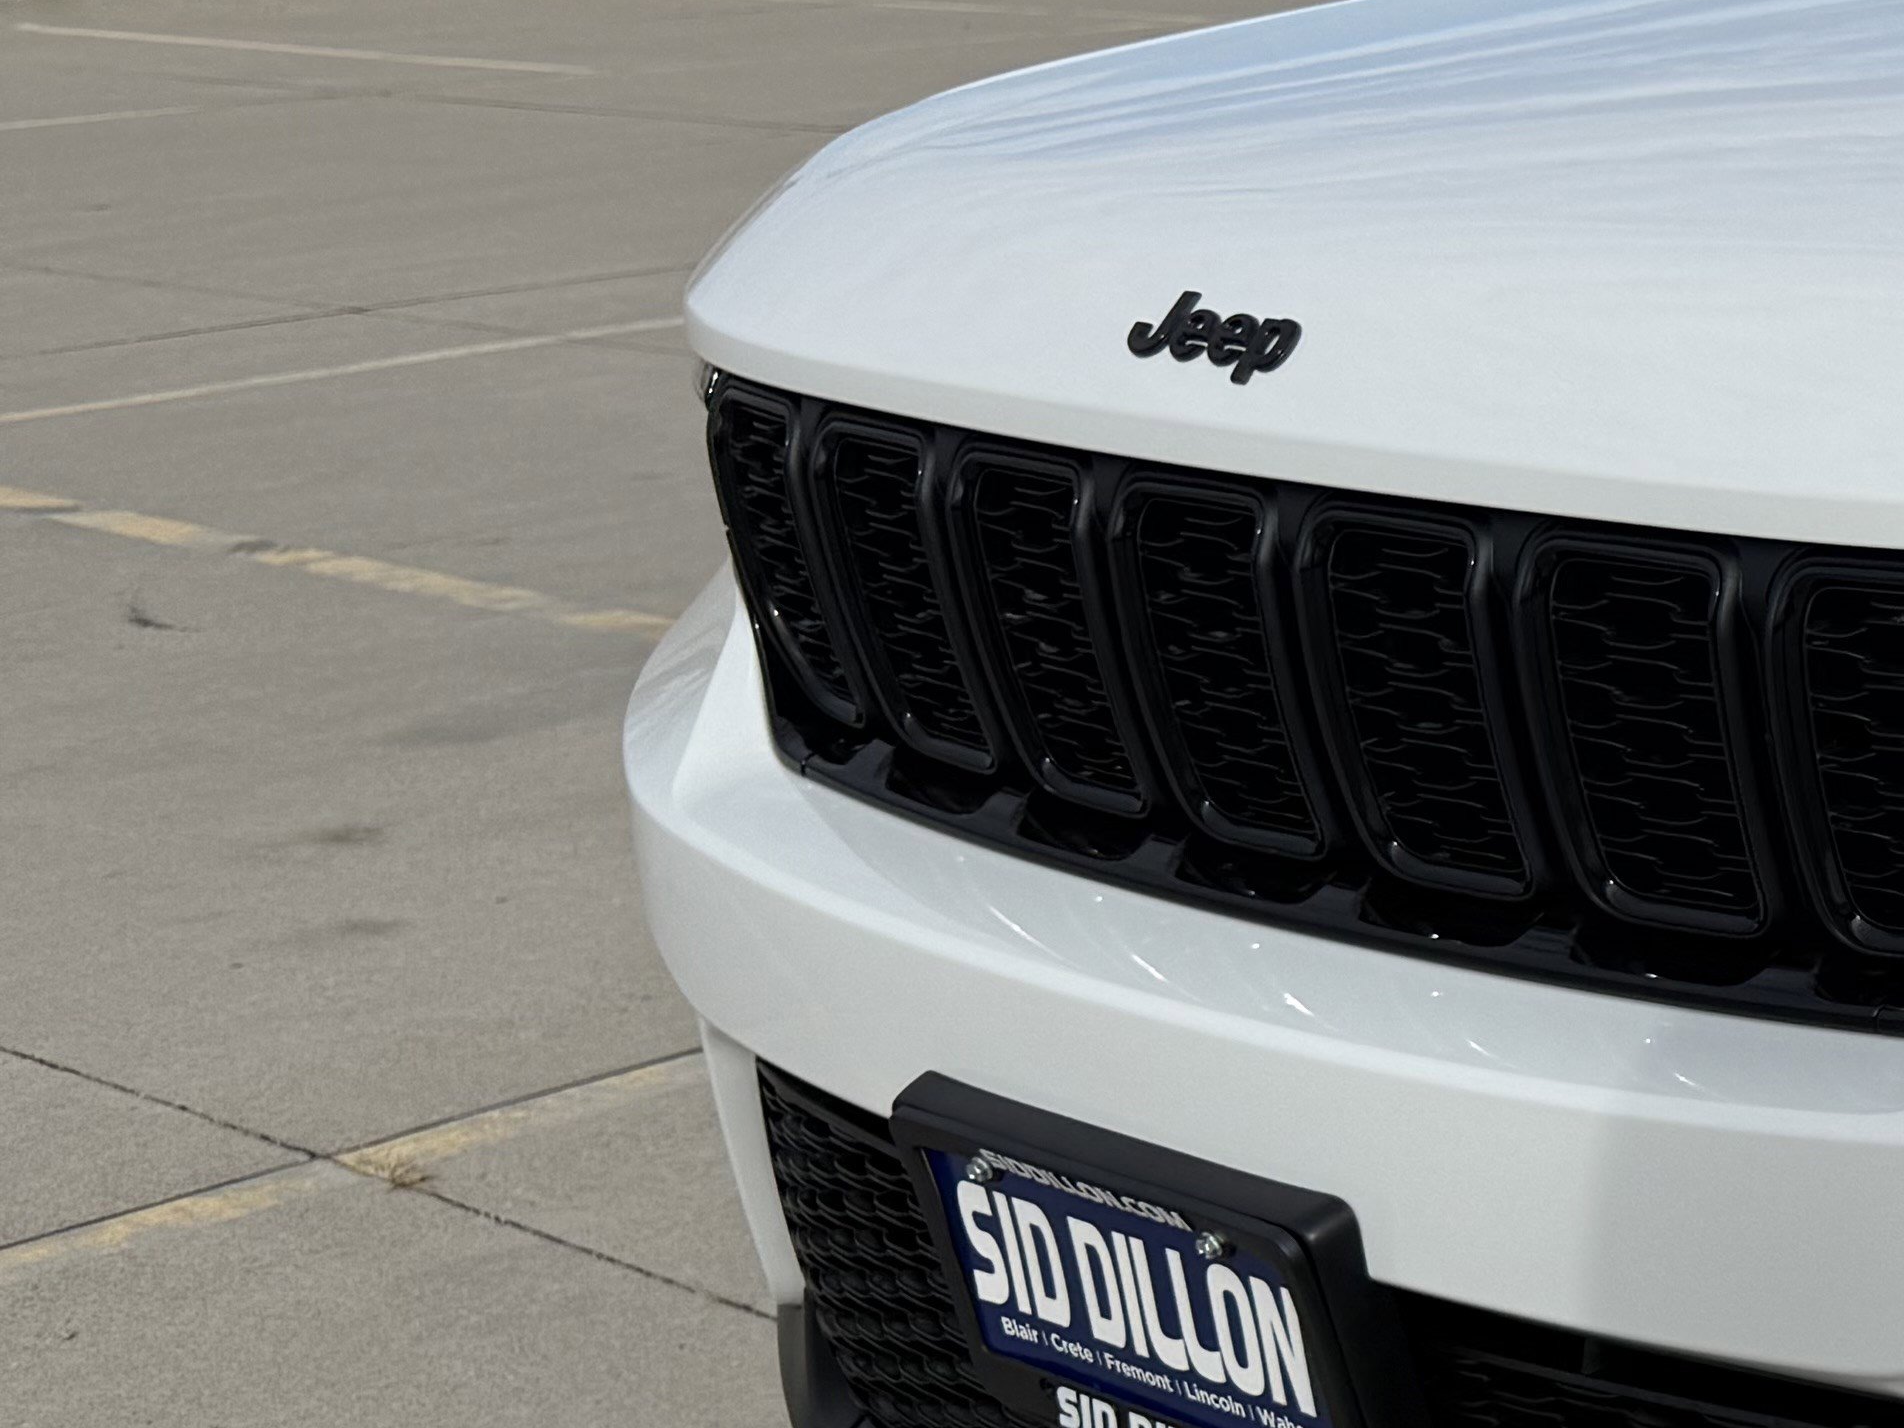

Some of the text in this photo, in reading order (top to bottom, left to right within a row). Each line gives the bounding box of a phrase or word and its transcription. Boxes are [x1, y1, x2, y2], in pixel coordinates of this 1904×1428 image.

[1127, 290, 1302, 386] Jeep
[978, 1147, 1193, 1233] SIDDILLON.COM
[956, 1179, 1318, 1418] SID DILLON
[1000, 1316, 1039, 1344] Blair
[1050, 1332, 1095, 1364] Crete
[1104, 1352, 1174, 1393] Fremont
[1183, 1380, 1246, 1418] Lincoln
